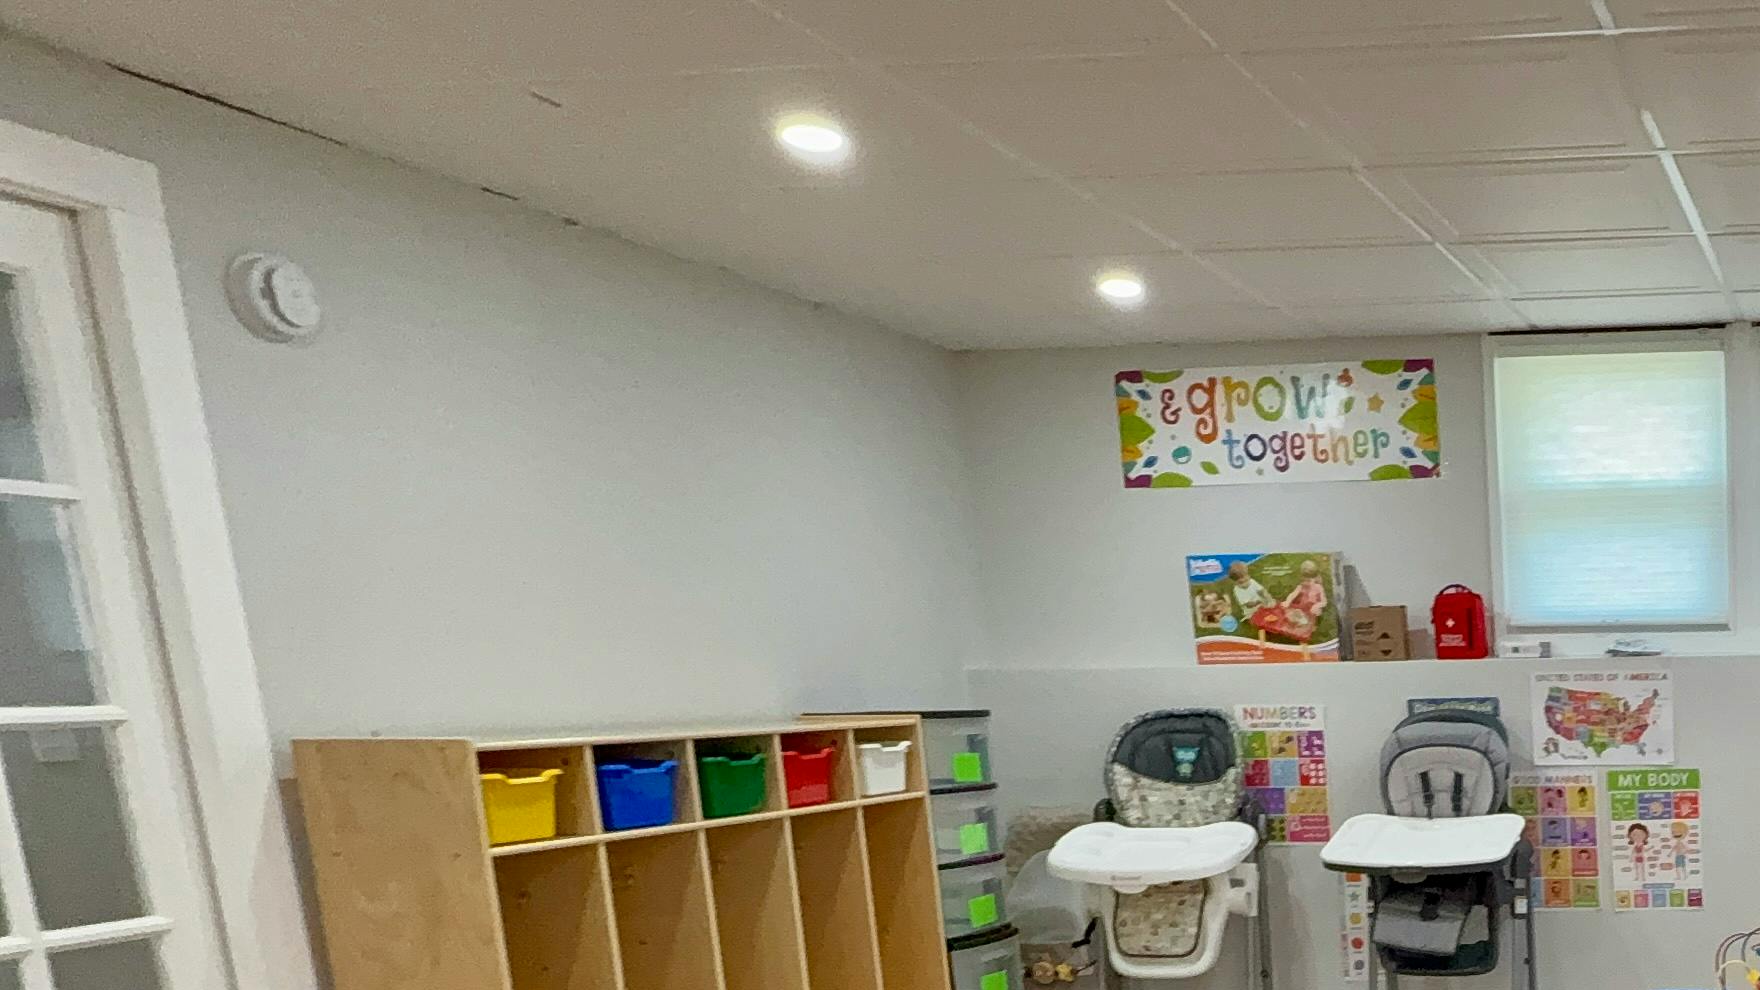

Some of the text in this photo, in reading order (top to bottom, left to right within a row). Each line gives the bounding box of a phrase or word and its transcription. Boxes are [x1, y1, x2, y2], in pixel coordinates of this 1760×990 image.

[1160, 373, 1331, 445] & grow
[1221, 423, 1391, 472] together
[1242, 706, 1317, 720] NUMBERS
[1618, 772, 1689, 787] MY BODY
